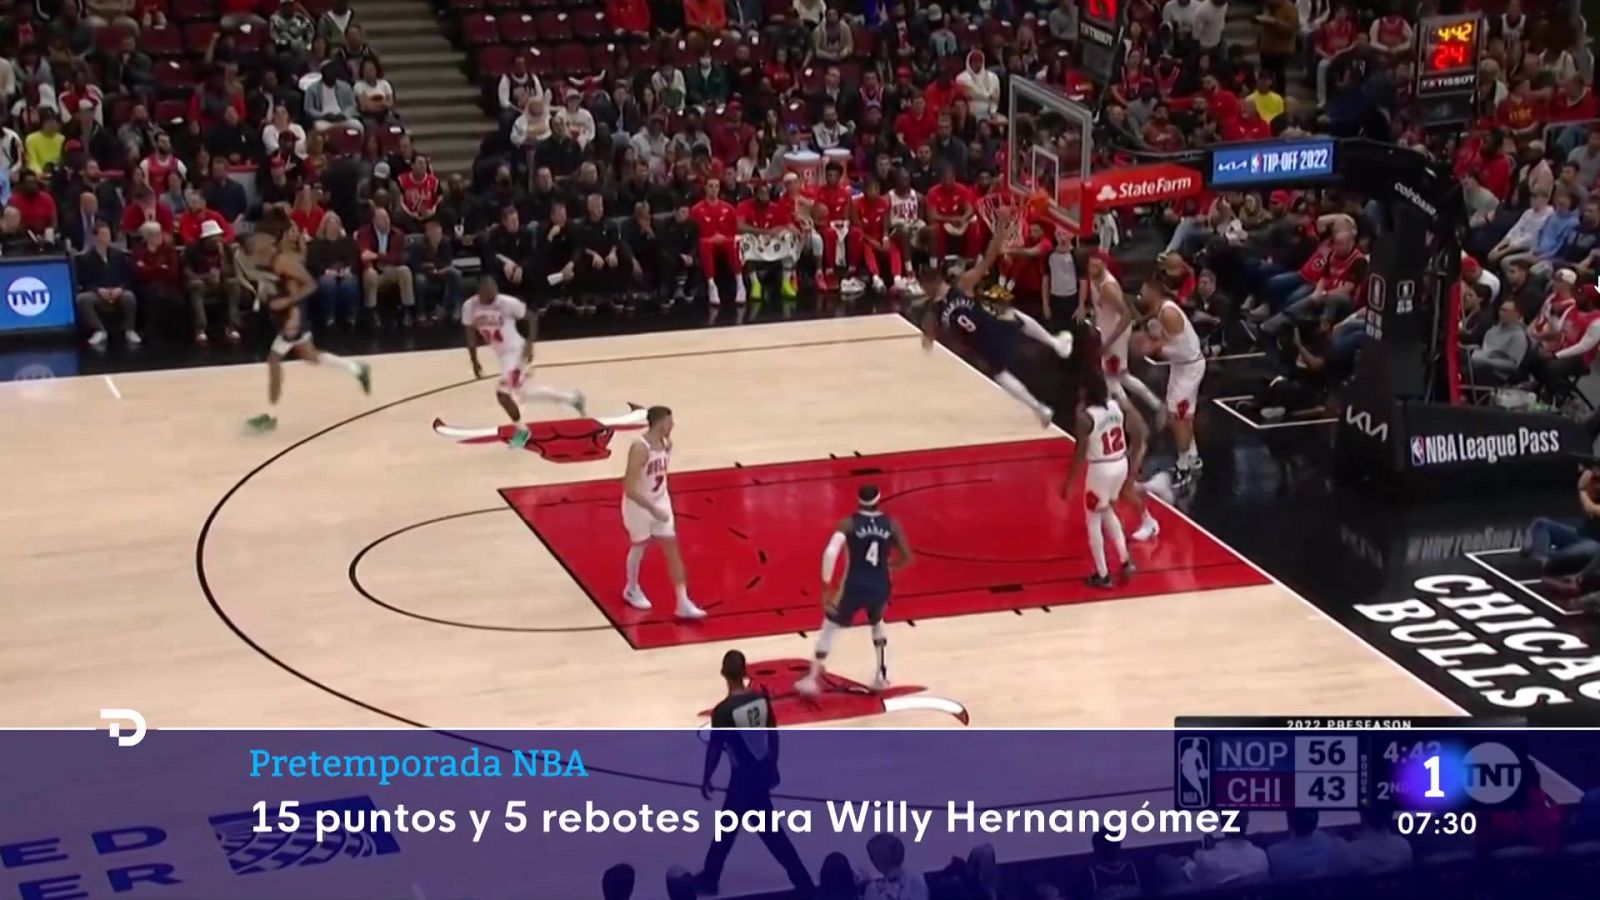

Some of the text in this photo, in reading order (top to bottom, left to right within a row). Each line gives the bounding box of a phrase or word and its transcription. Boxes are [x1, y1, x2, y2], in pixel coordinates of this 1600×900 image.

[1434, 44, 1465, 70] 24
[1437, 74, 1476, 88] TISSOT
[1263, 152, 1298, 173] TIP-OFF
[1300, 148, 1328, 170] 2022
[1394, 181, 1437, 217] coinbase
[8, 288, 49, 307] TNT
[1100, 425, 1125, 456] 12
[1426, 426, 1560, 464] NBA League Pass
[652, 474, 665, 492] 7
[865, 540, 879, 567] 4
[1414, 574, 1600, 701] CHICA
[1353, 601, 1575, 708] BULLS
